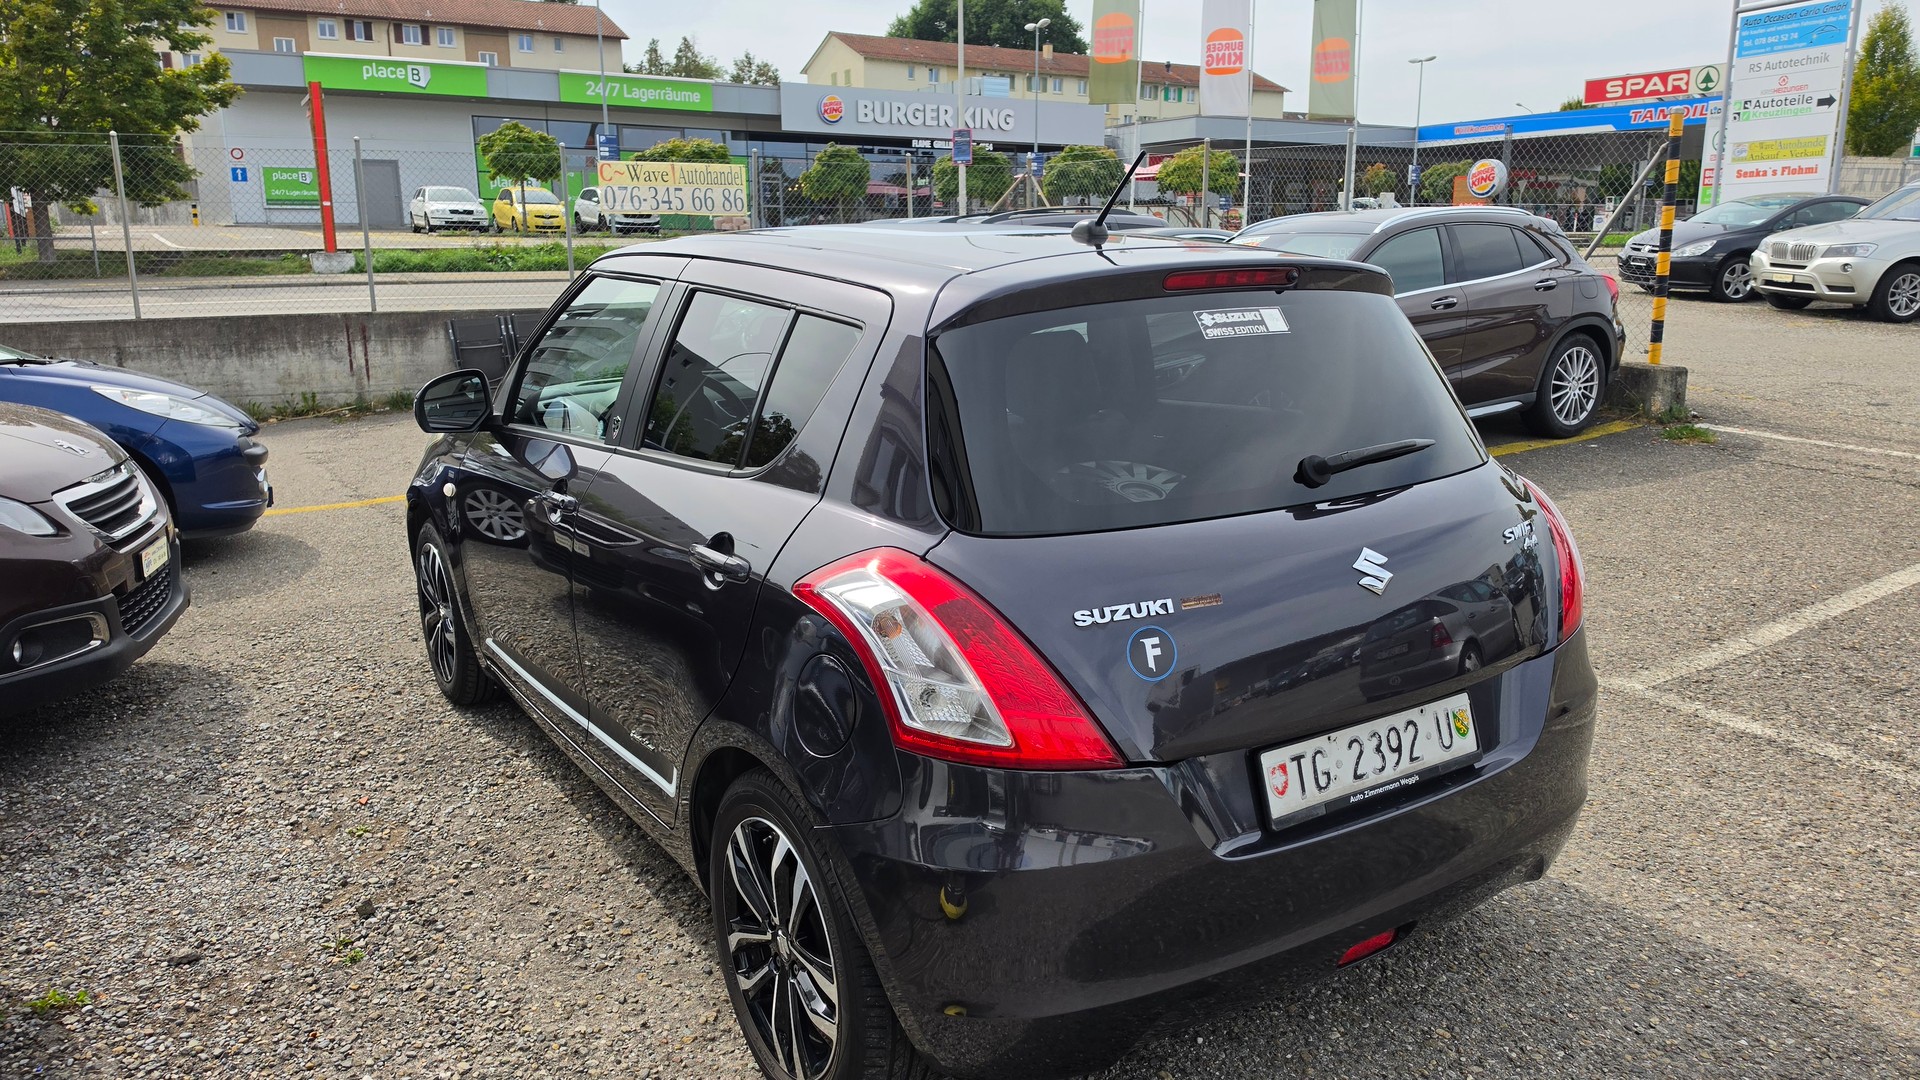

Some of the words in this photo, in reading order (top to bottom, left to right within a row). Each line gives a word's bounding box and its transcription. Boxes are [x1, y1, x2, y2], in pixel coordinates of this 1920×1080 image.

[1743, 17, 1761, 27] Auto
[1764, 11, 1798, 24] Occasion
[1799, 7, 1820, 18] Carlo
[1823, 2, 1848, 14] GmbH
[1748, 62, 1762, 73] RS
[1764, 52, 1830, 71] Autotechnik
[362, 62, 406, 80] place
[410, 67, 421, 82] B
[585, 81, 620, 97] 24/7
[623, 83, 701, 102] Lagerräume
[1605, 72, 1689, 98] SPAR
[1753, 95, 1814, 109] Autoteile
[822, 106, 843, 116] KING
[856, 100, 954, 128] BURGER
[961, 106, 1015, 131] KING
[1751, 105, 1813, 118] Kreuzlingen
[1454, 123, 1505, 135] Willkommen
[911, 139, 932, 148] FLAME
[1777, 137, 1827, 150] Autohandel
[1749, 151, 1779, 161] Ankauf
[1790, 148, 1824, 158] Verkauf
[272, 171, 299, 181] place
[678, 165, 744, 186] Autohandel
[1471, 166, 1496, 180] BURGER
[1780, 164, 1819, 176] Flohmi
[1471, 173, 1496, 188] KING
[603, 185, 685, 211] 076-345
[691, 187, 715, 212] 66
[722, 188, 745, 212] 86
[1213, 311, 1262, 324] SUZUKI
[1206, 326, 1235, 337] SWISS
[1234, 324, 1268, 335] EDITION
[1073, 598, 1175, 627] SUZUKI
[1139, 636, 1162, 672] F
[1290, 746, 1331, 800] TG
[1347, 719, 1424, 783] 2392
[1433, 708, 1454, 752] U
[1350, 793, 1364, 804] Auto
[1364, 781, 1400, 799] Zimmermann
[1400, 774, 1420, 788] Weggis
